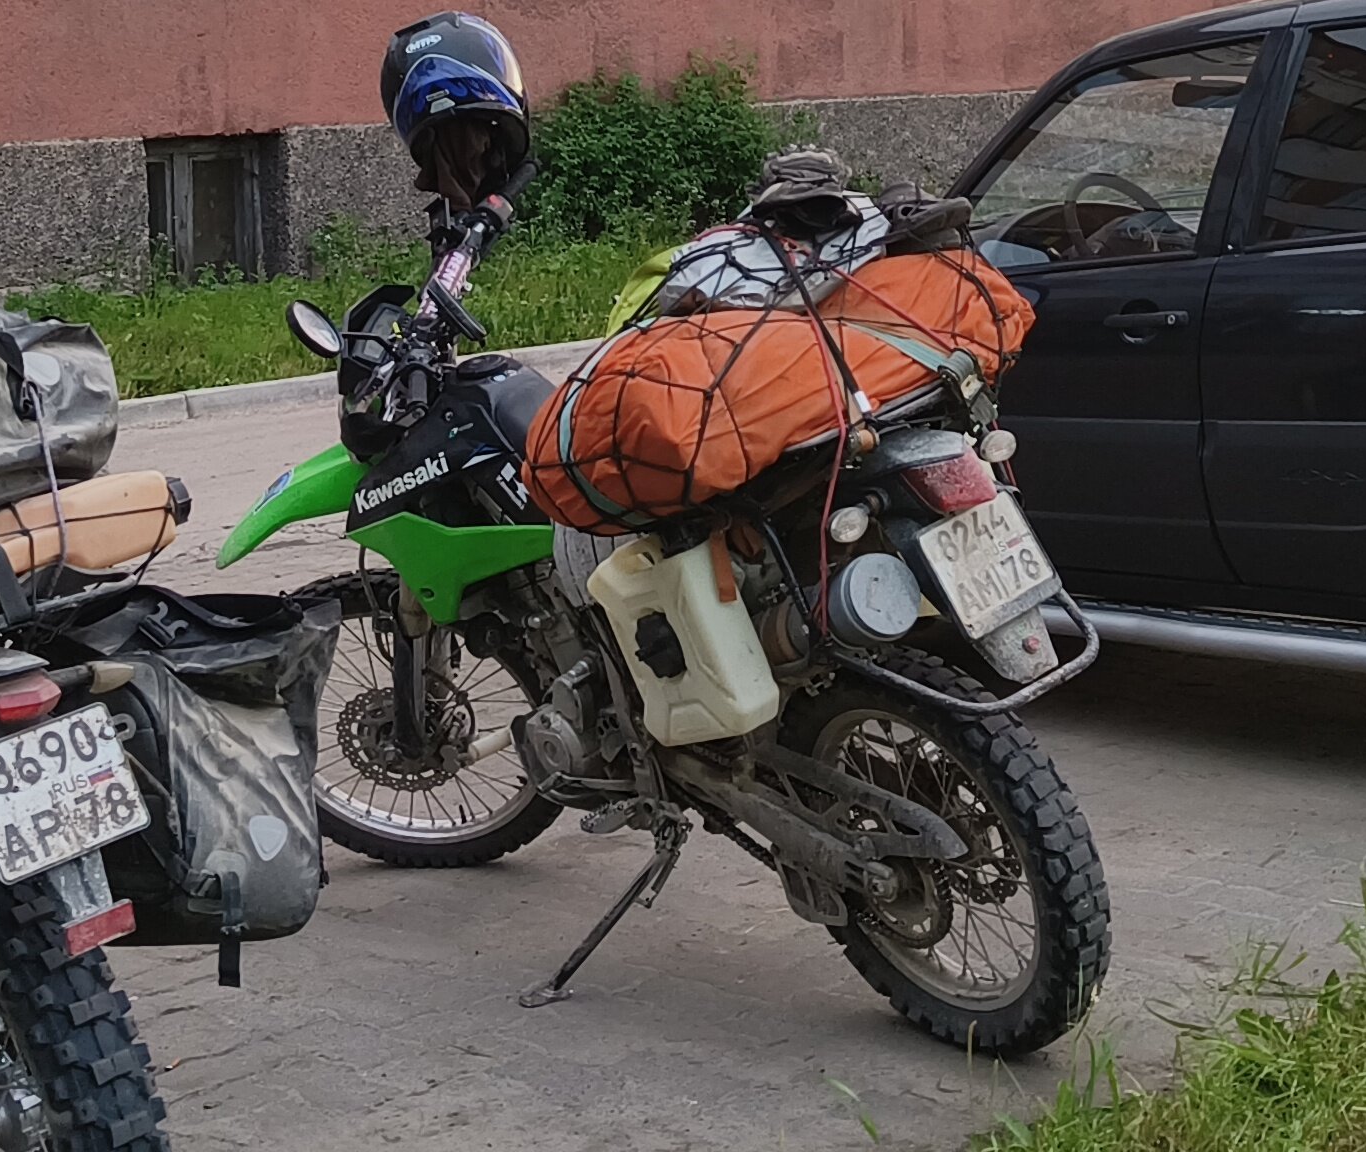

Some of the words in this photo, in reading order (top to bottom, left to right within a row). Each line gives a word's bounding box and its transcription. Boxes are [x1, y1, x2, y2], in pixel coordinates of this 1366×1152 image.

[354, 451, 450, 514] Kawasaki
[936, 503, 1011, 563] 8244
[999, 548, 1042, 590] 78
[50, 773, 89, 800] RUS
[4, 808, 63, 873] АР
